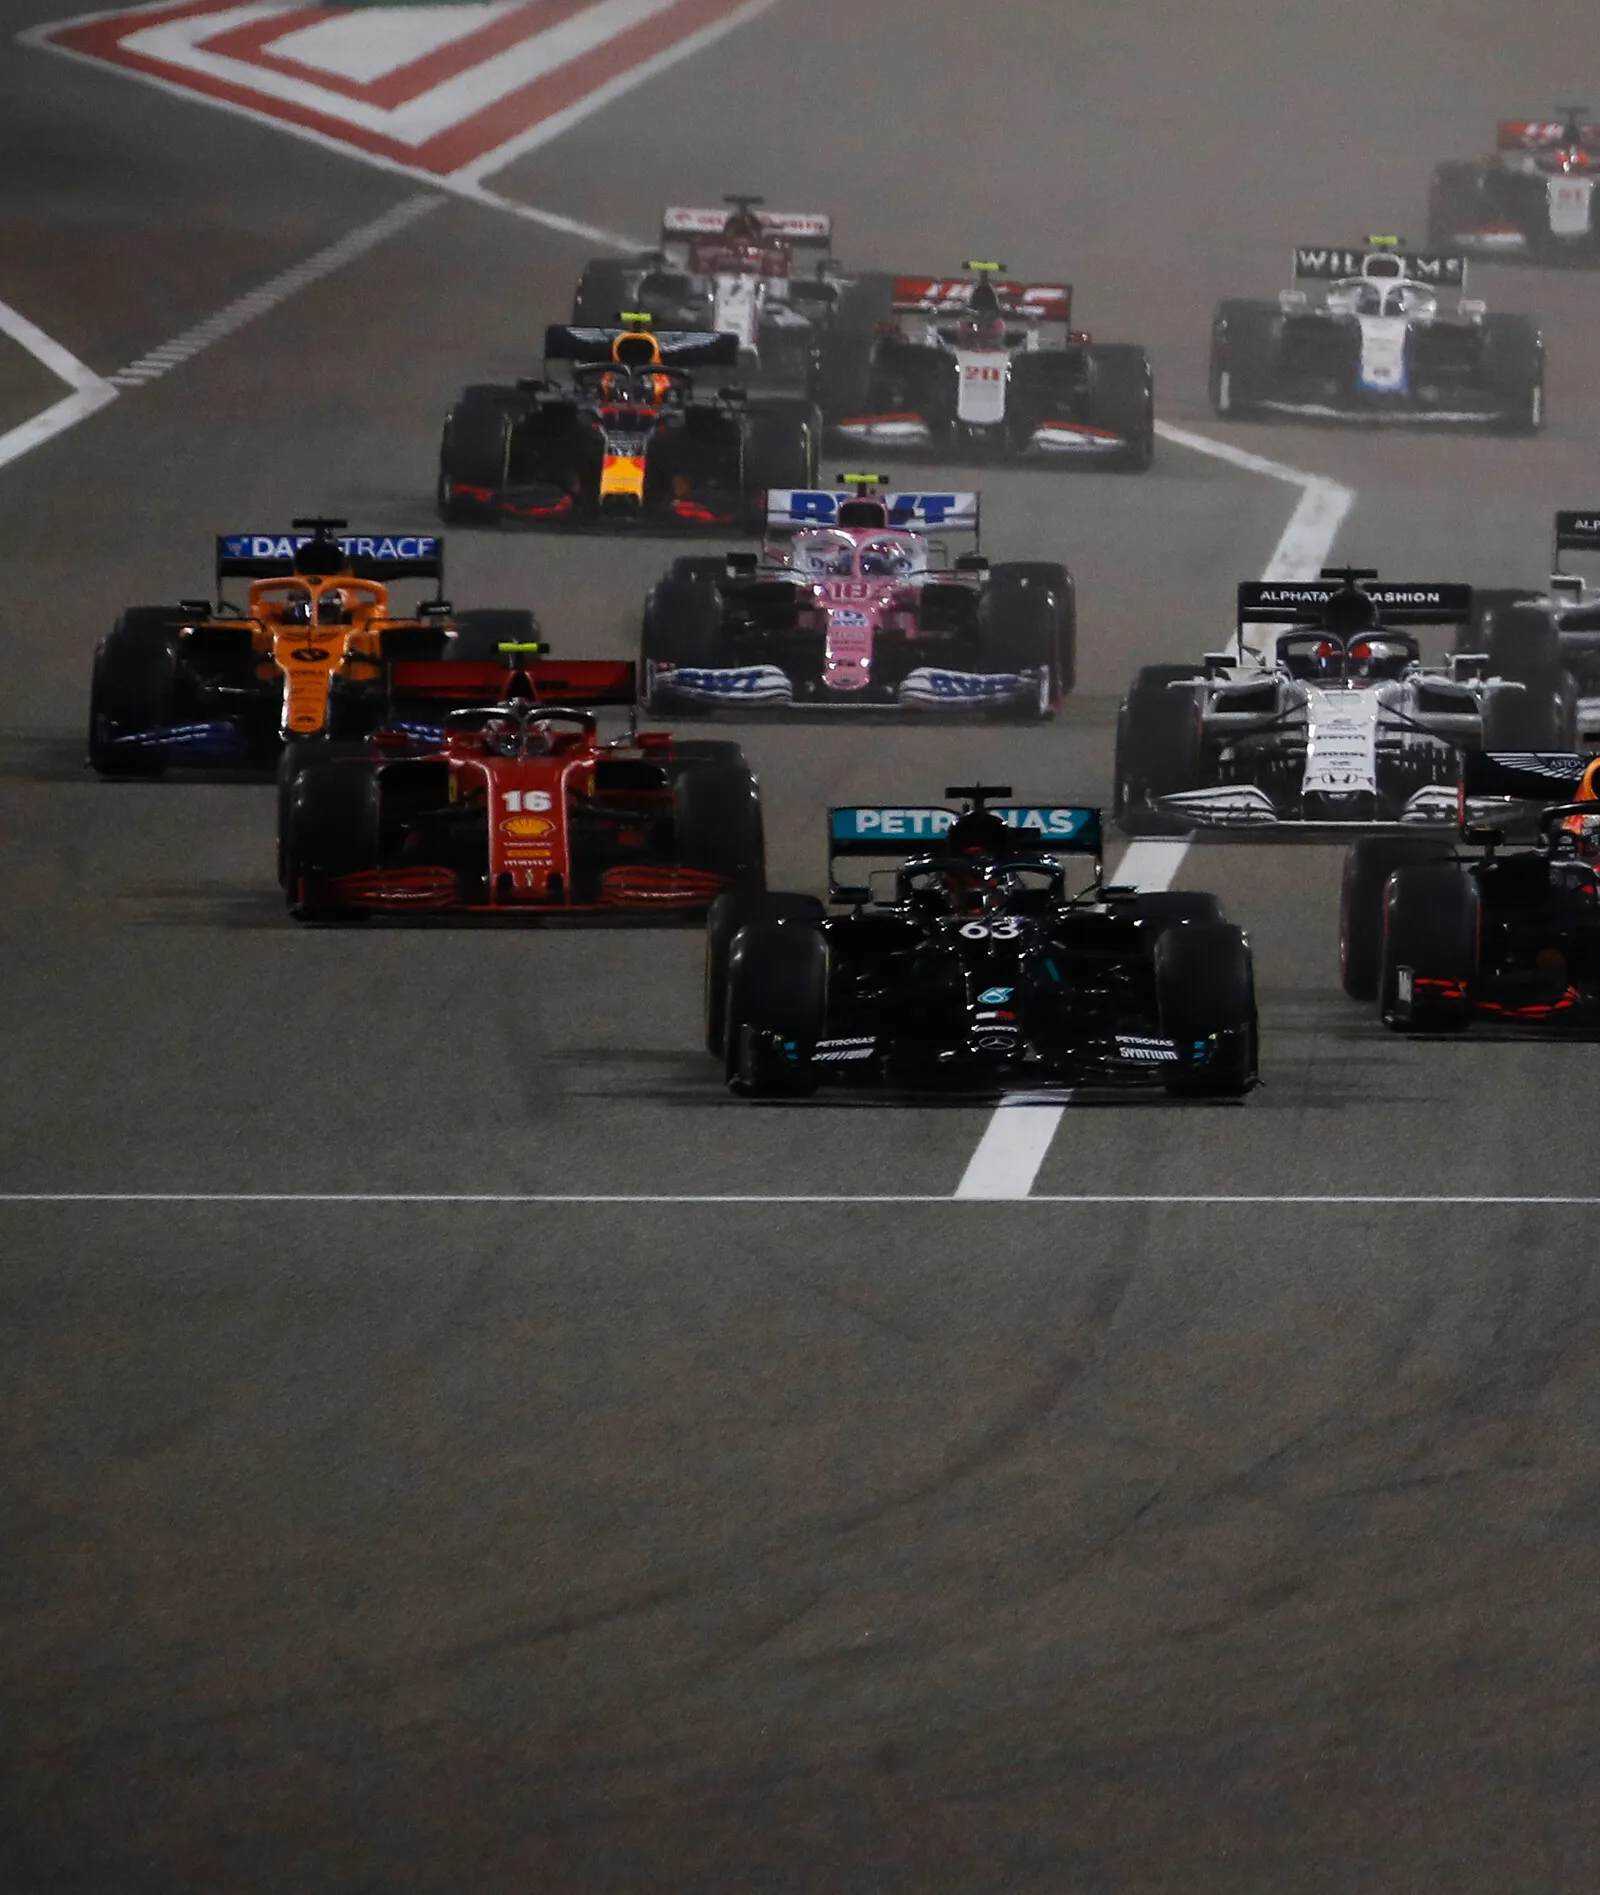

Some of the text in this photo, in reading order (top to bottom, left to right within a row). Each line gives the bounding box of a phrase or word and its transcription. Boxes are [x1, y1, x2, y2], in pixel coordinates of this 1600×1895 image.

[1300, 250, 1459, 277] WILMS
[790, 493, 955, 525] BT
[252, 537, 434, 558] DATRACE
[1260, 591, 1334, 603] ALPHATA
[501, 790, 552, 812] 16
[856, 809, 1074, 834] PETRNAS
[959, 921, 1020, 939] 63
[815, 1036, 876, 1048] PETRONAS
[1115, 1035, 1175, 1047] PETRONAS
[1119, 1047, 1178, 1060] SYNTIUM
